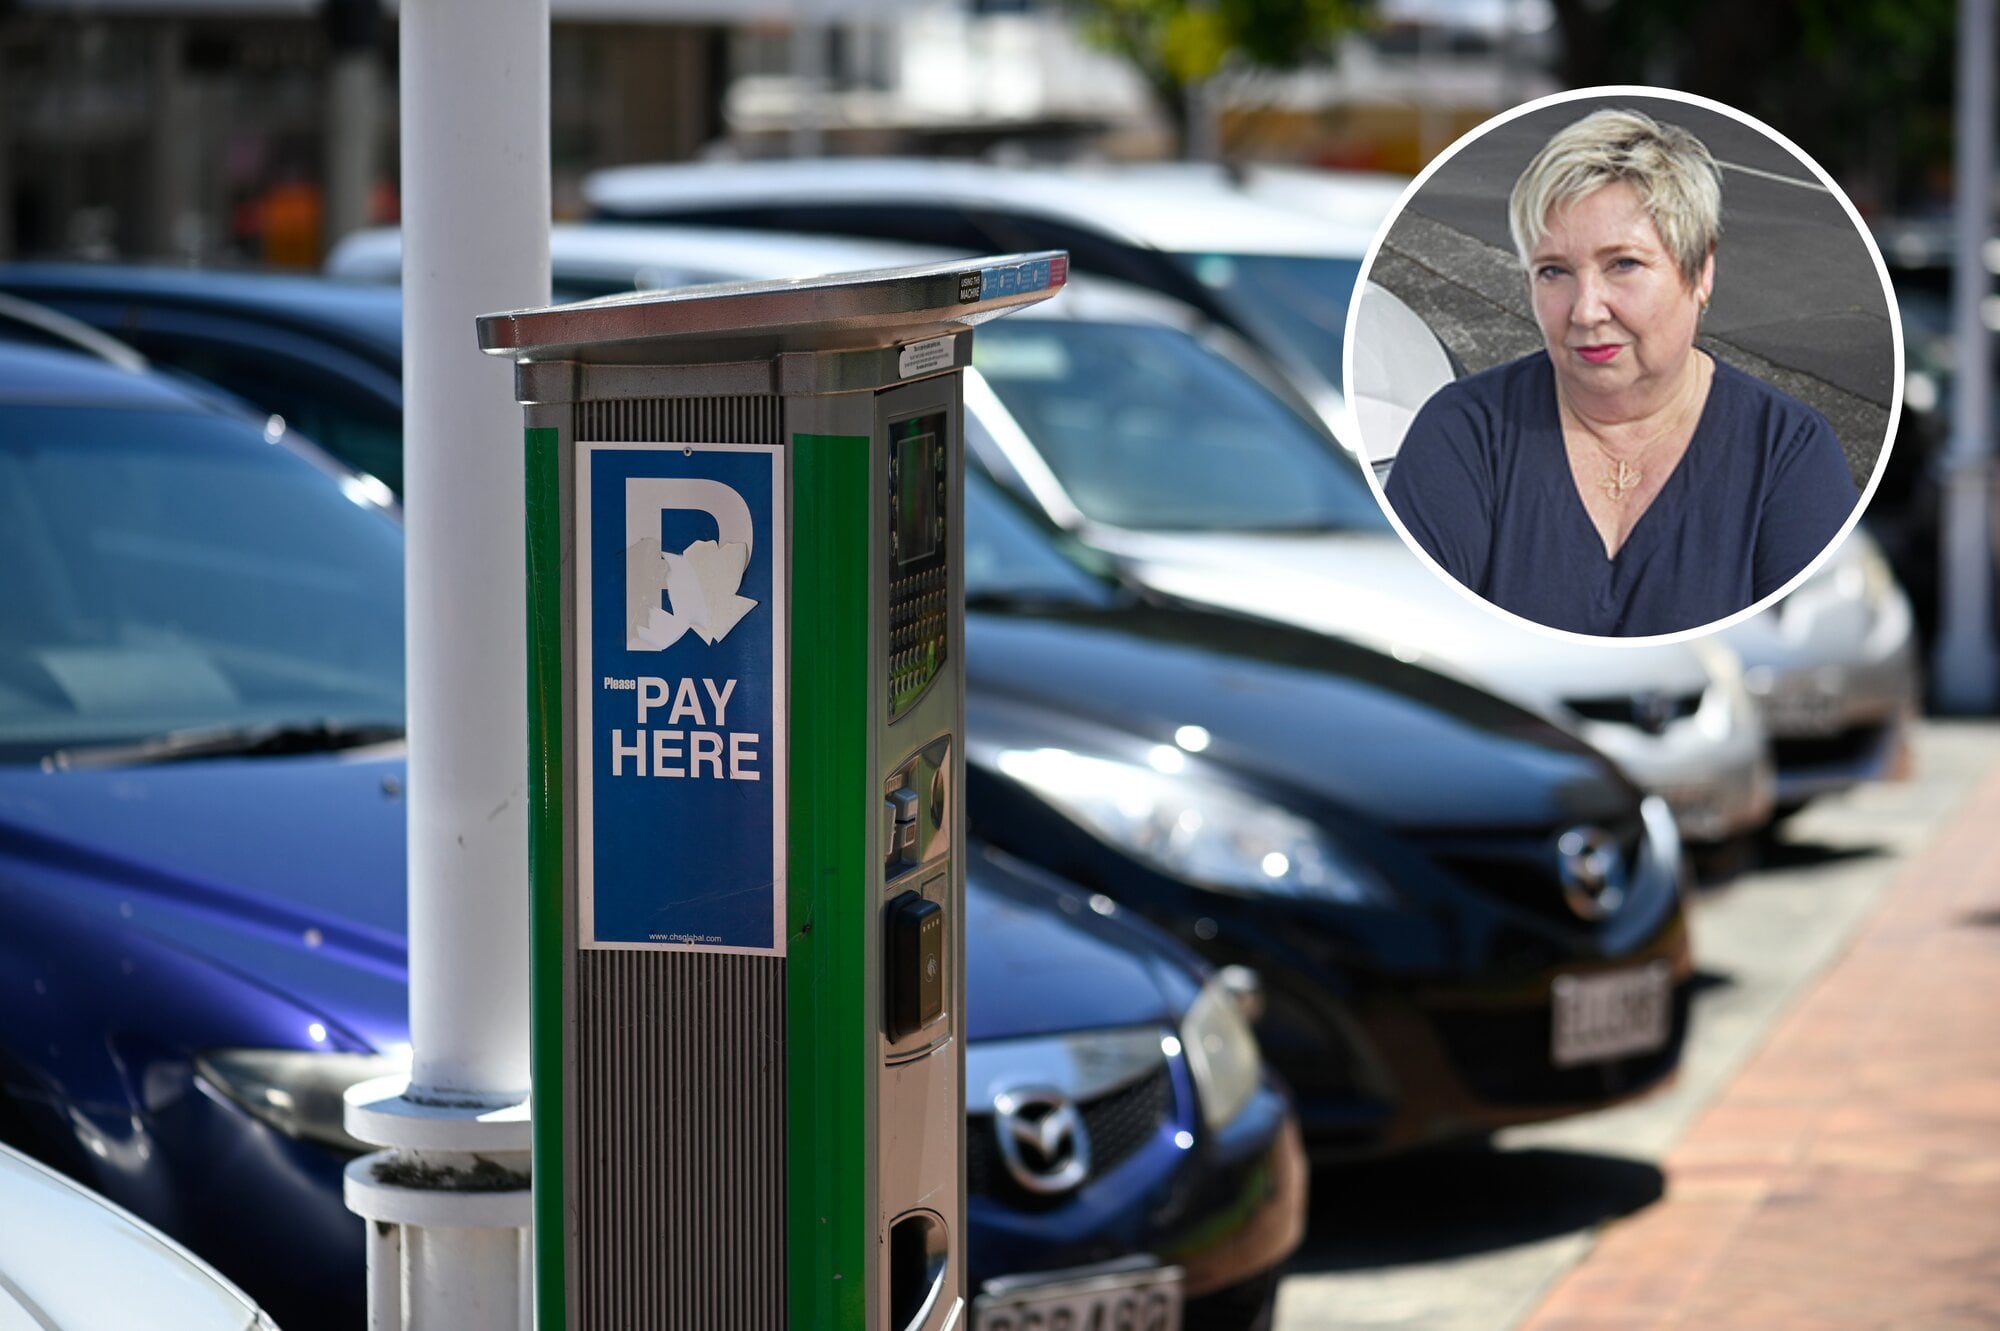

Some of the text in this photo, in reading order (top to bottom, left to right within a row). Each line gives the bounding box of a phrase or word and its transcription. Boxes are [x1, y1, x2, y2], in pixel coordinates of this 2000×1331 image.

[960, 286, 981, 300] MACHINE
[604, 676, 738, 726] Please PAY
[612, 729, 761, 781] HERE
[648, 933, 722, 943] www.chsglobal.com
